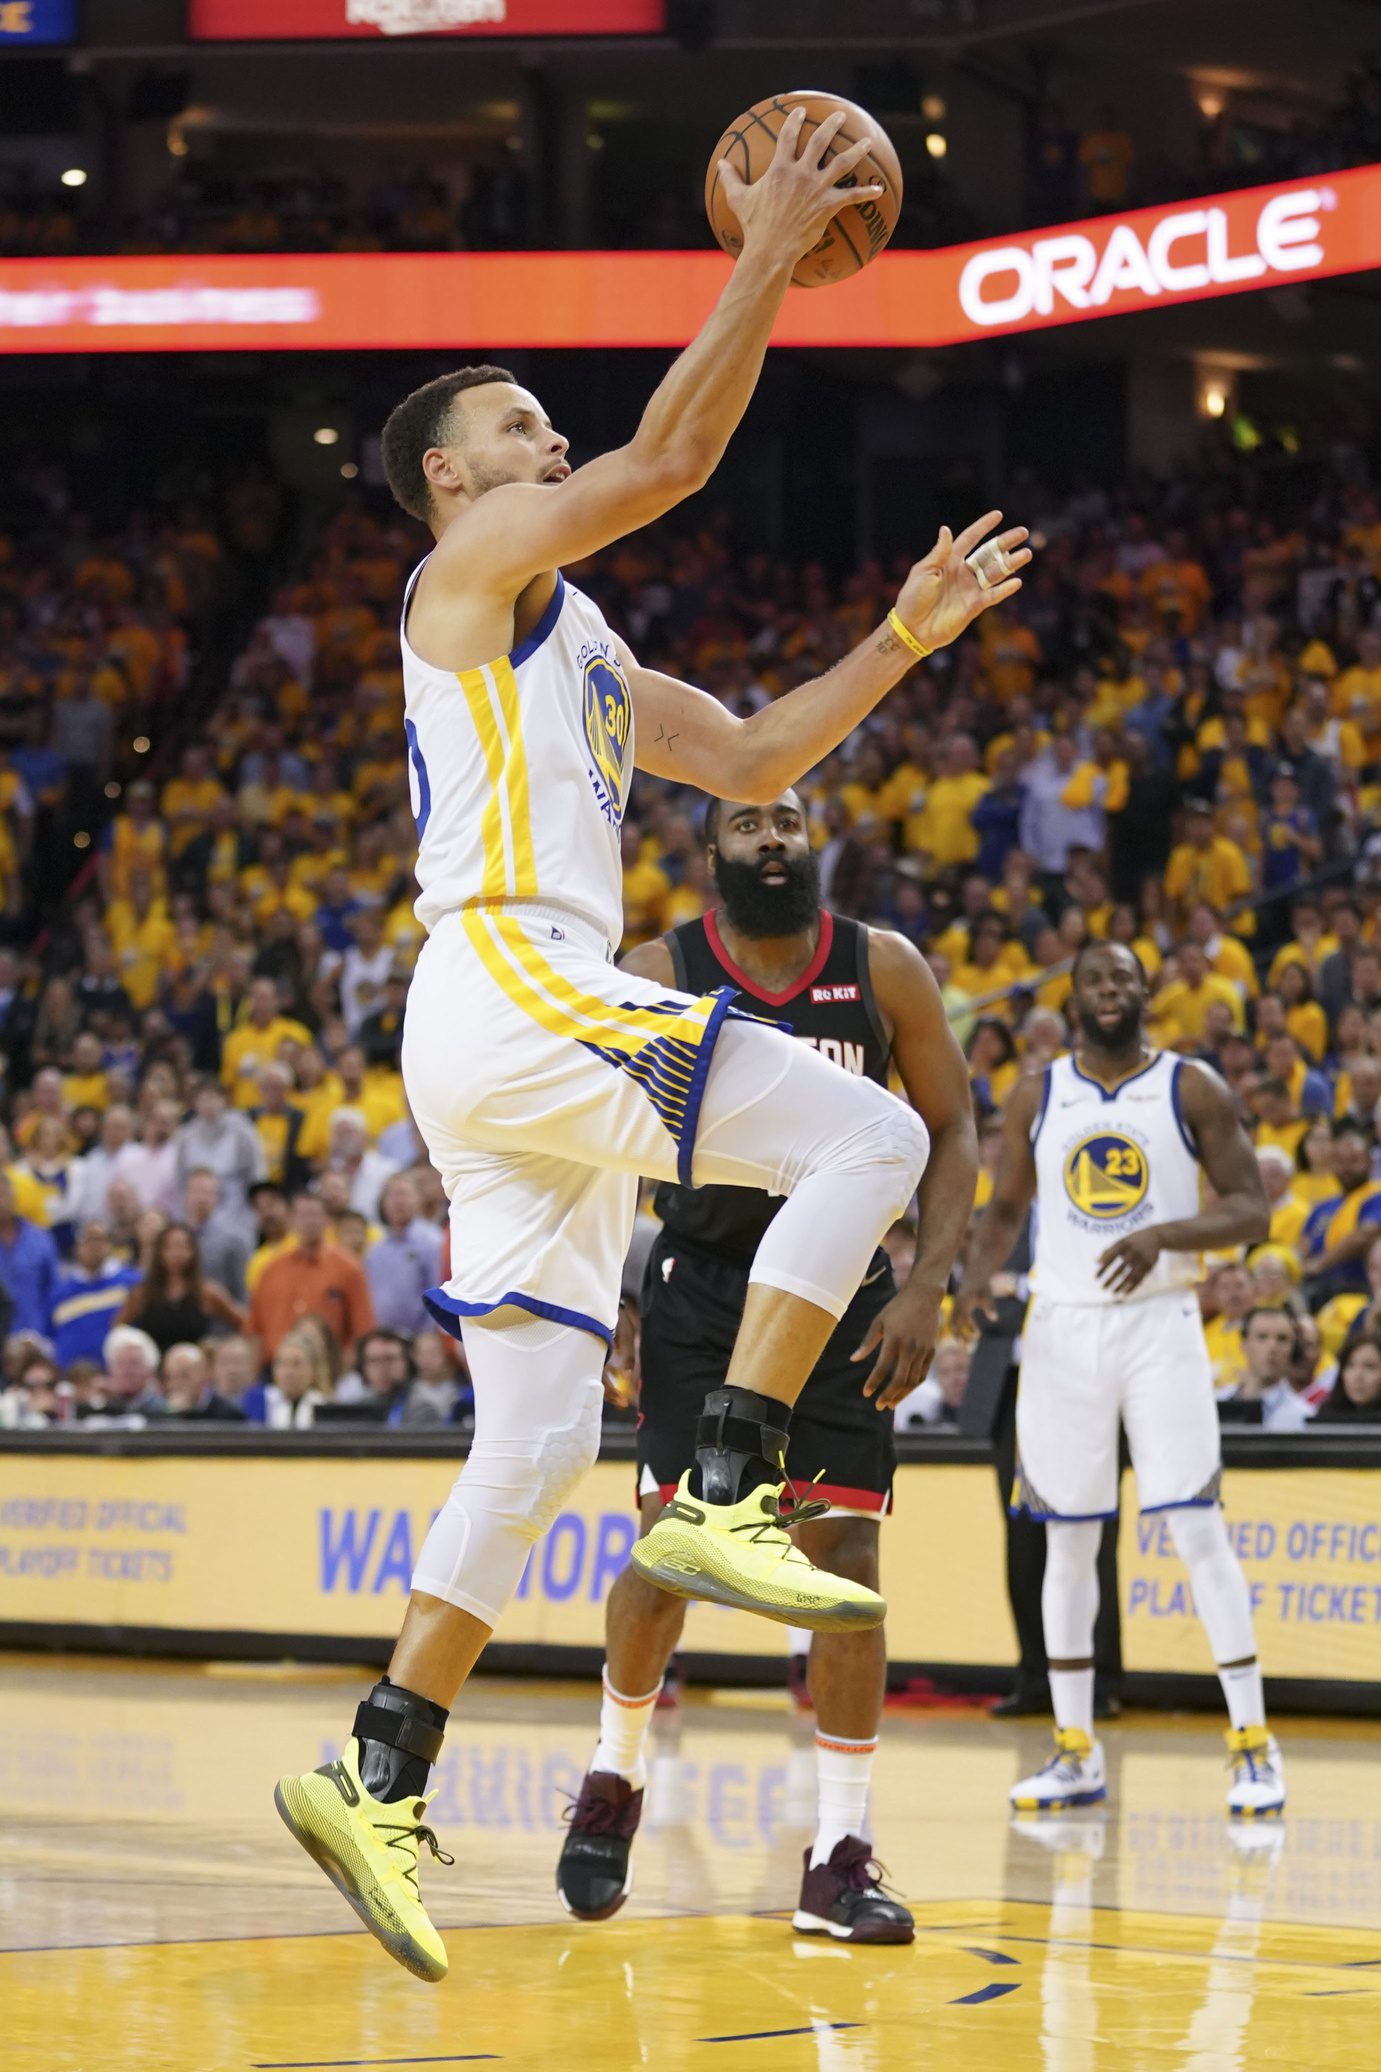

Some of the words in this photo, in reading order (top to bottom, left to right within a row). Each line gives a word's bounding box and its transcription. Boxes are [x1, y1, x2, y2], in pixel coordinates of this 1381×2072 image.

[959, 189, 1325, 326] ORACLE
[605, 694, 624, 746] 30
[1105, 1147, 1140, 1176] 23
